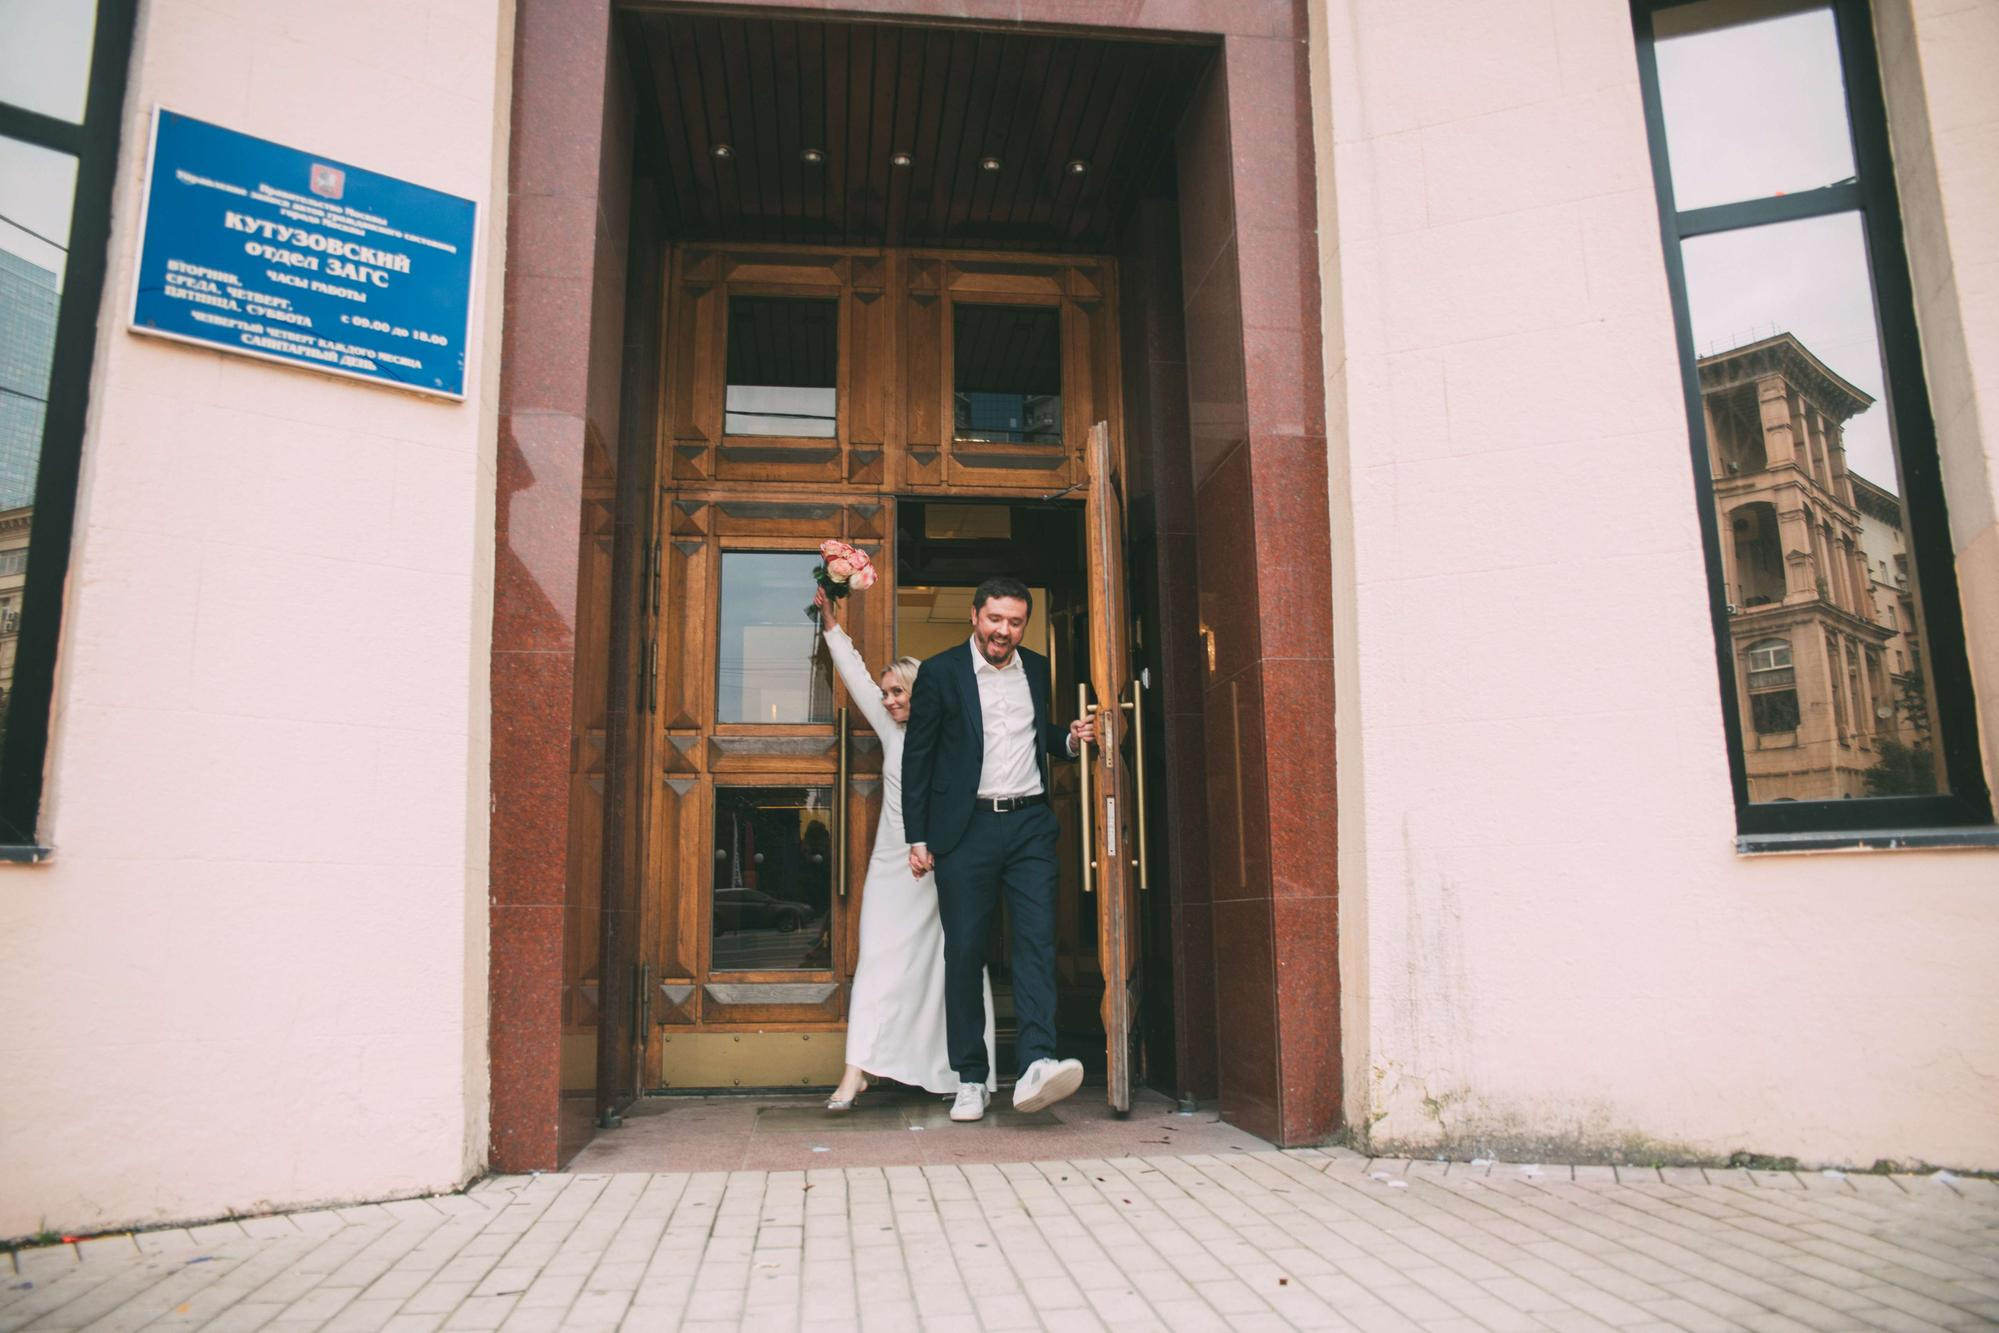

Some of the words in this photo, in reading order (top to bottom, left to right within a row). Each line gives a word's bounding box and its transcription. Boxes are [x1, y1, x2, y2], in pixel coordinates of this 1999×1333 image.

[224, 210, 412, 275] КУТУЗОВСКИЙ
[244, 240, 319, 272] отдел
[325, 257, 390, 289] ЗАГС
[265, 269, 309, 290] ЧАСЫ
[310, 279, 368, 304] РАБОТЫ
[245, 302, 313, 328] СУББОТА
[340, 313, 351, 325] с
[350, 315, 391, 334] 09.00
[390, 326, 410, 338] до
[412, 329, 449, 347] 18.00
[240, 332, 339, 363] САНИТАРНЫЙ
[339, 353, 379, 372] ДЕНЬ
